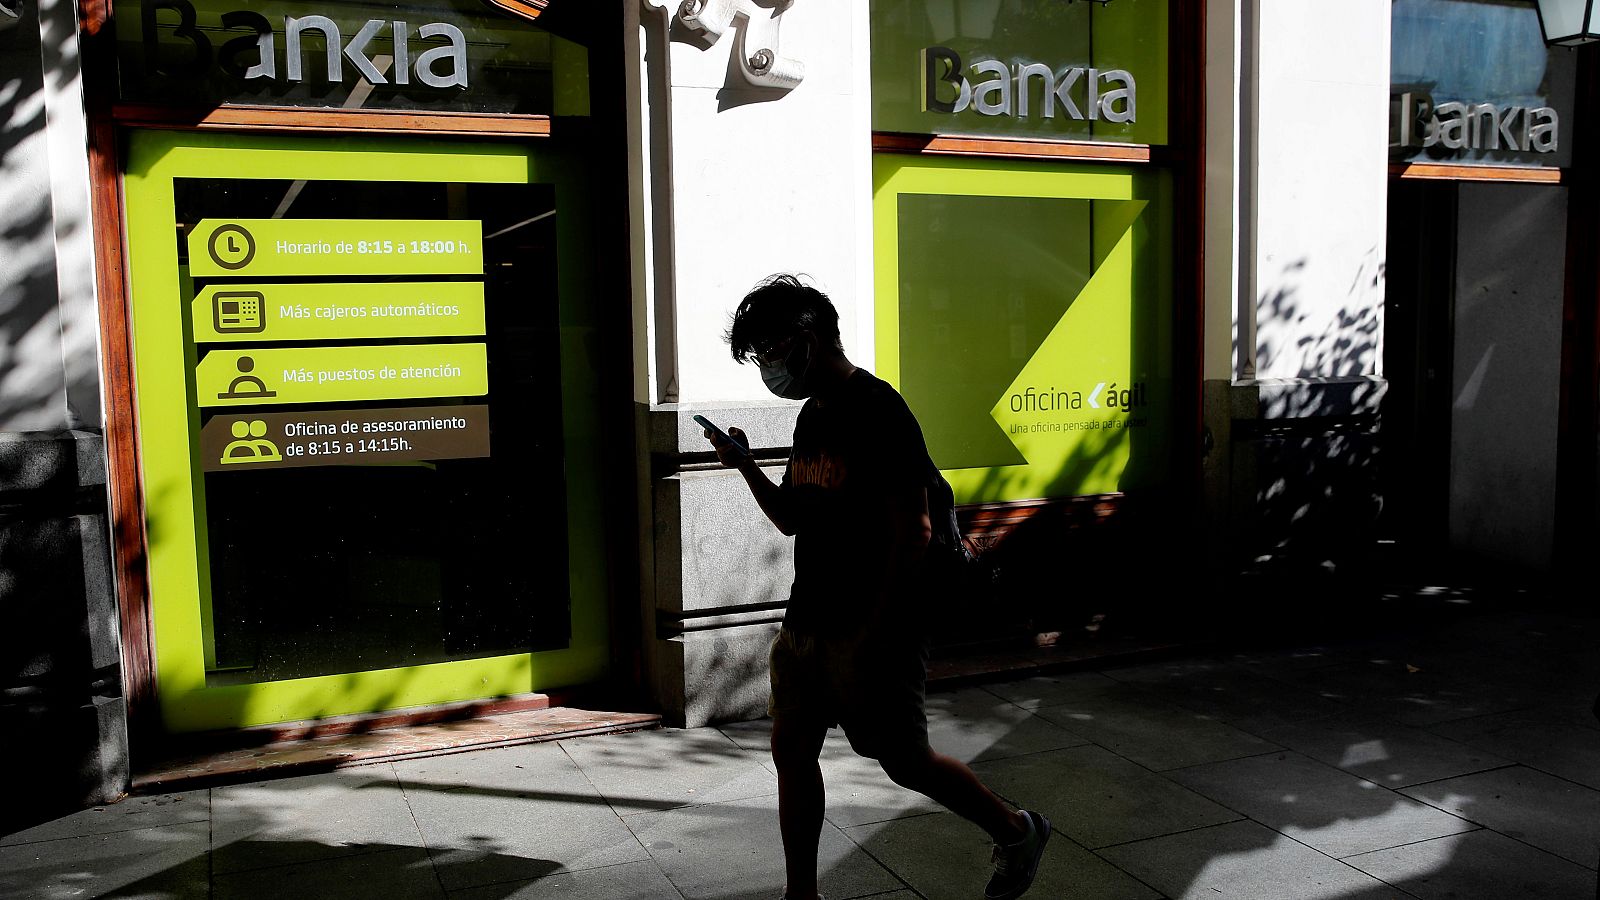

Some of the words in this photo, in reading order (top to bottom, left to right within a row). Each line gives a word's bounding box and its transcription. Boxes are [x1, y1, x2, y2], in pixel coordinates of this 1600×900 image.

[141, 0, 468, 90] Bankia
[920, 46, 1136, 123] Bankia
[1401, 92, 1559, 153] Bankia
[276, 240, 331, 255] Horario
[335, 240, 353, 254] de
[357, 240, 393, 254] 8:15
[398, 243, 406, 254] a
[410, 240, 454, 254] 18:00
[458, 240, 471, 254] h.
[279, 304, 311, 320] Más
[315, 305, 367, 320] cajeros
[371, 303, 459, 318] automáticos
[283, 368, 314, 383] Más
[318, 369, 375, 384] puestos
[379, 366, 397, 380] de
[400, 364, 461, 380] atención
[1010, 387, 1082, 412] oficina
[1106, 383, 1147, 412] ágil
[284, 422, 337, 437] Oficina
[340, 420, 358, 435] de
[362, 416, 466, 434] asesoramiento
[1010, 424, 1028, 434] Una
[1031, 422, 1060, 433] oficina
[1063, 420, 1100, 433] pensada
[1102, 418, 1122, 431] para
[286, 442, 304, 457] de
[308, 440, 341, 455] 8:15
[345, 443, 354, 454] a
[358, 437, 412, 453] 14:15h.
